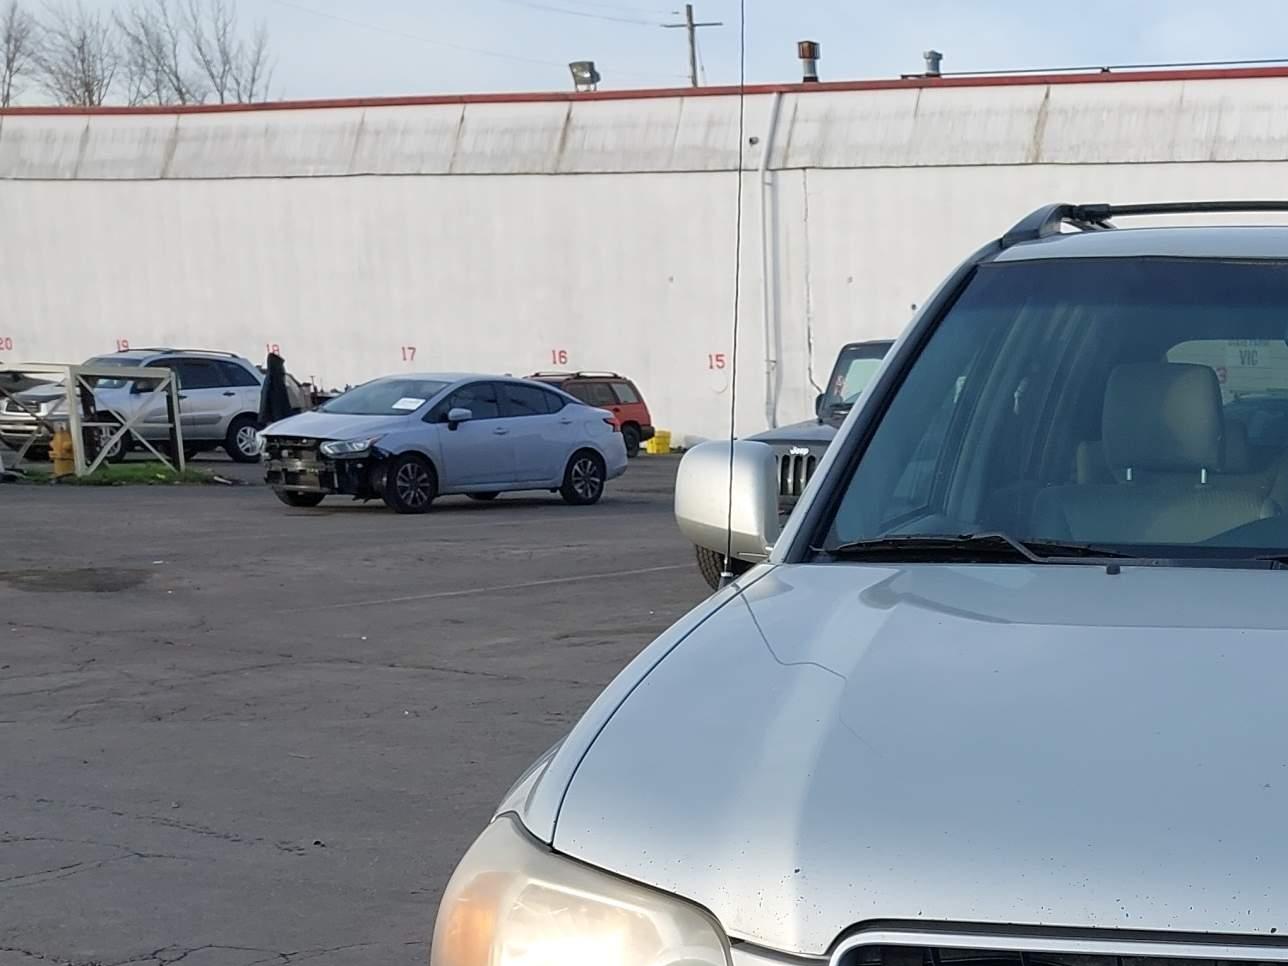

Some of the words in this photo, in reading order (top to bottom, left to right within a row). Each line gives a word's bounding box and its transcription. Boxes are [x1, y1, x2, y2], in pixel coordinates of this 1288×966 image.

[401, 346, 417, 361] 17
[552, 350, 568, 365] 16
[708, 353, 725, 370] 15
